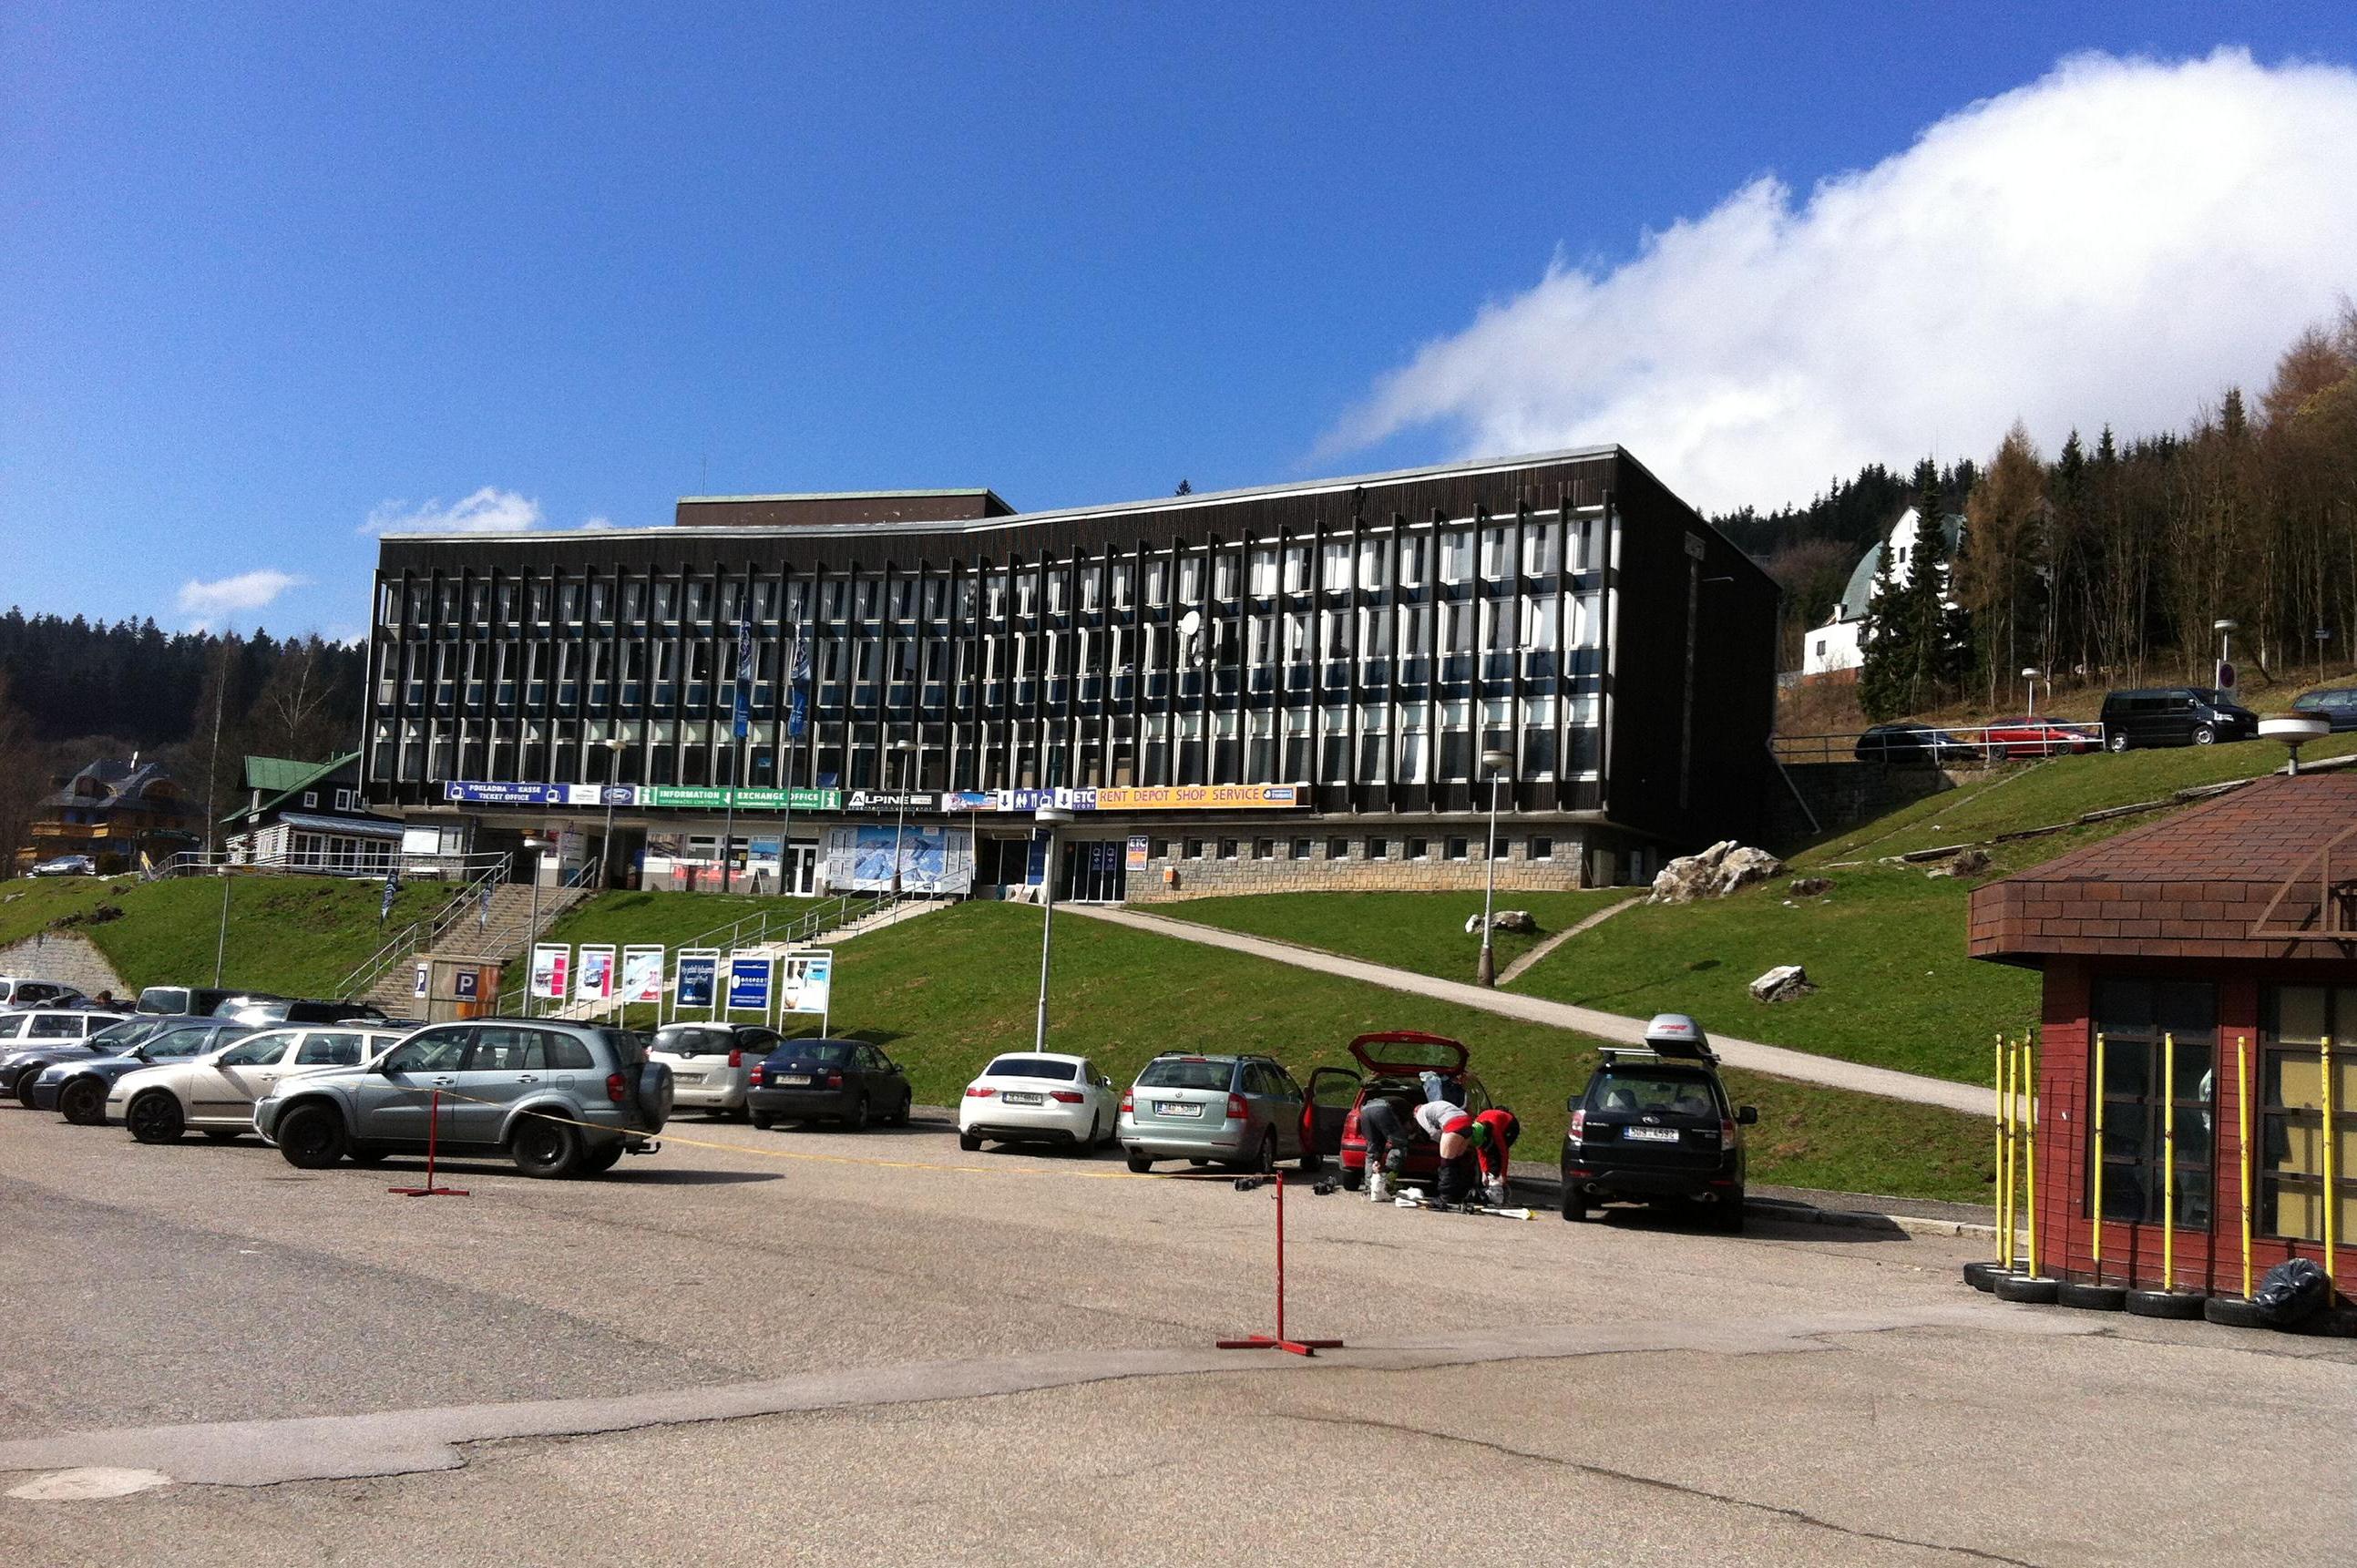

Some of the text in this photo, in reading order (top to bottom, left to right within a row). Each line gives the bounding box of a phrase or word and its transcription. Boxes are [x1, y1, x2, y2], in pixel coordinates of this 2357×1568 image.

[660, 790, 720, 799] INFORMATION
[737, 792, 784, 800] EXCHANGE
[848, 791, 910, 806] ALPINE
[1073, 791, 1095, 804] ETC
[1100, 790, 1128, 802] RENT
[1133, 790, 1170, 802] DEPOT
[1176, 789, 1207, 801] SHOP
[1213, 787, 1259, 801] SERVICE
[415, 971, 425, 990] P
[459, 975, 474, 992] P
